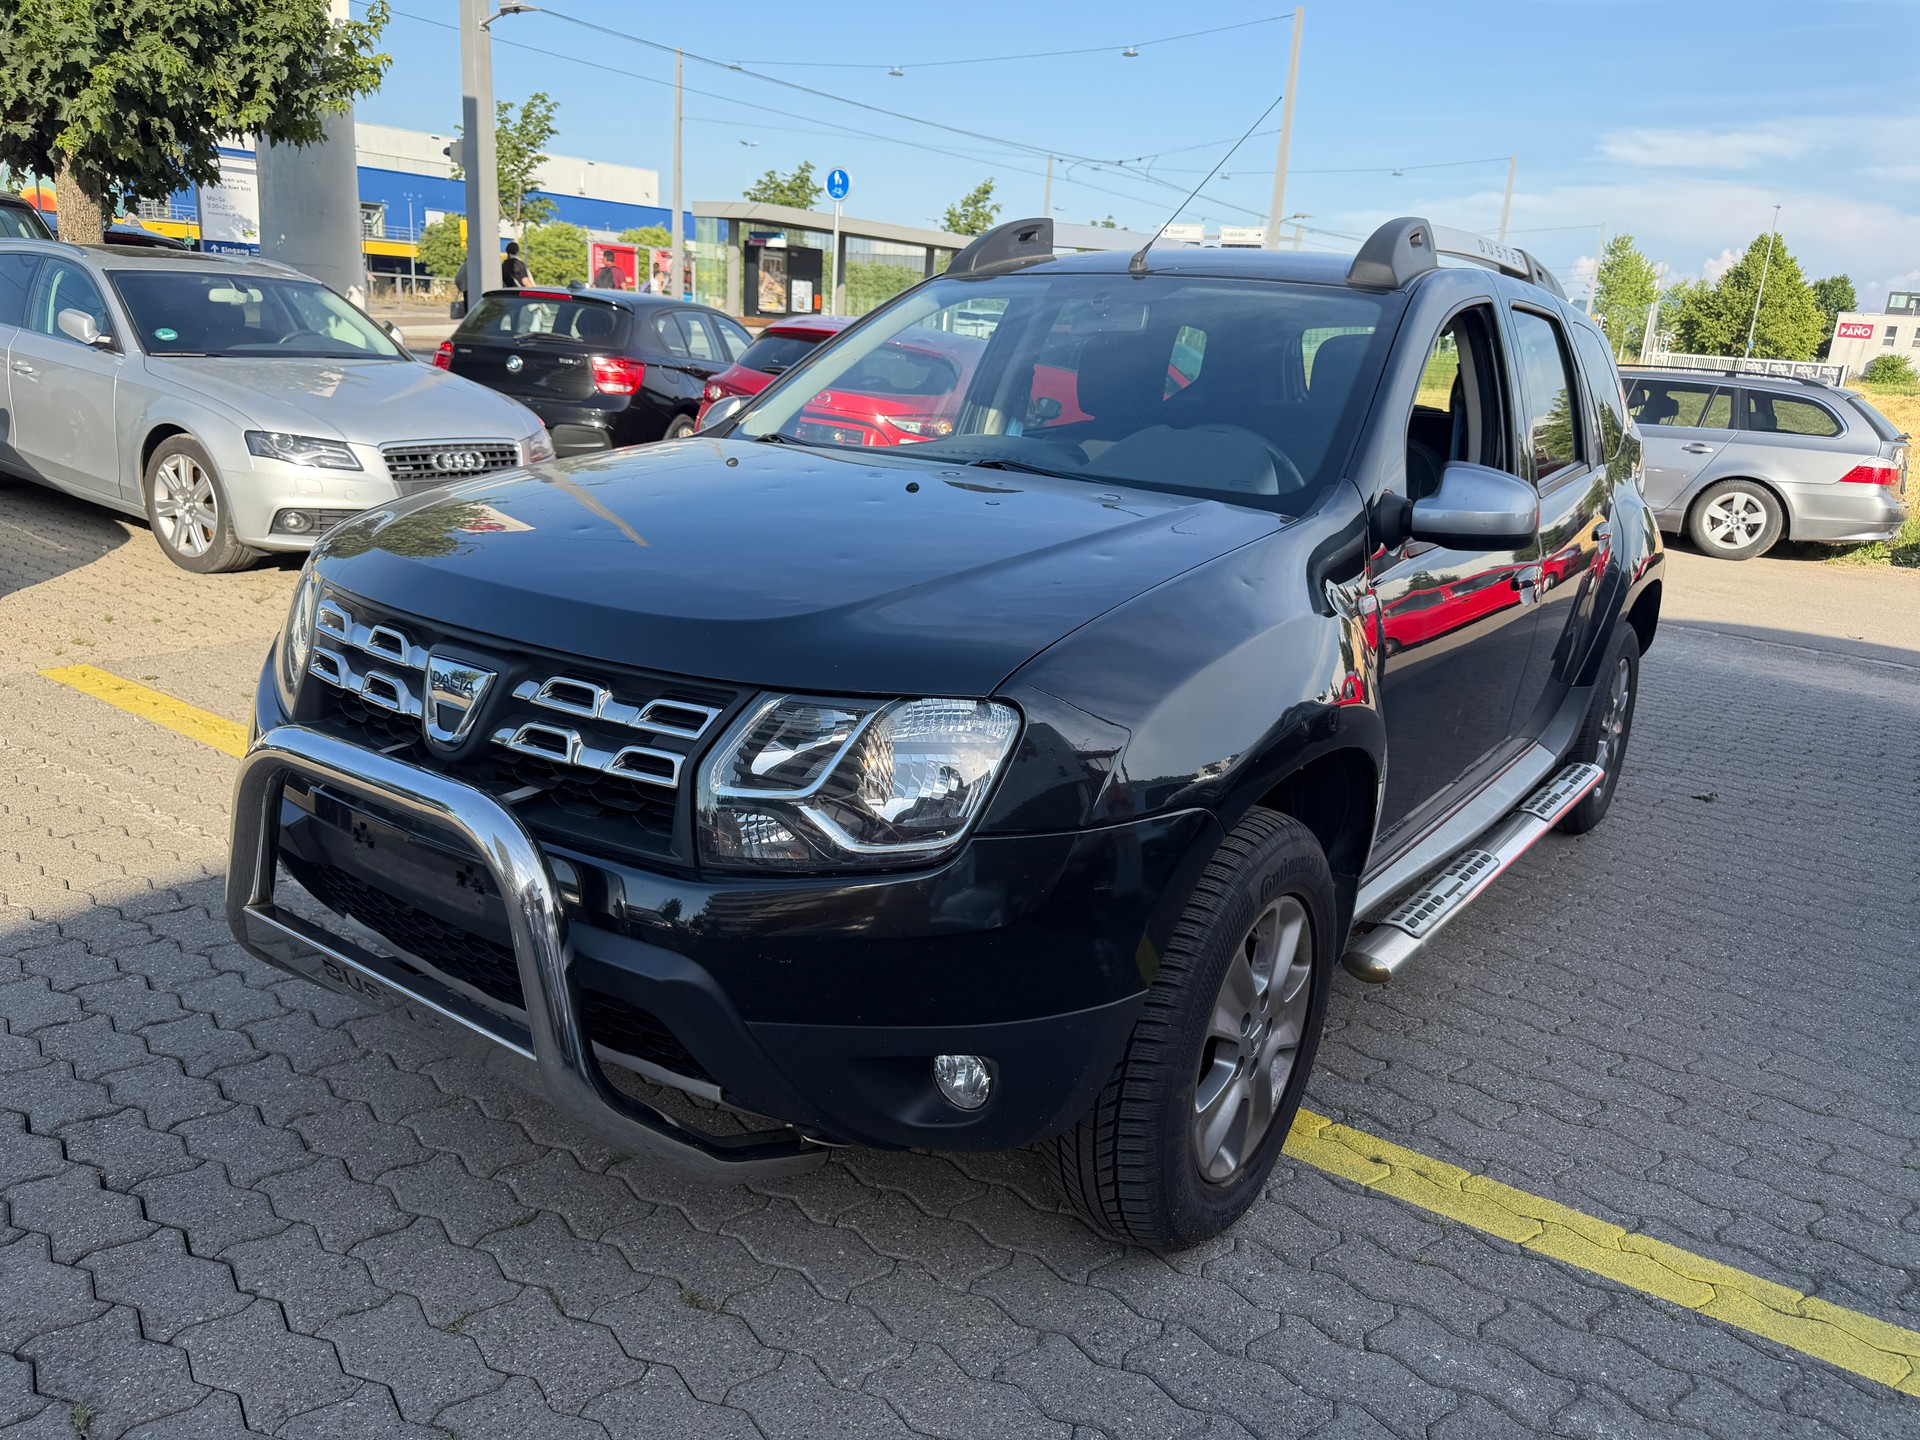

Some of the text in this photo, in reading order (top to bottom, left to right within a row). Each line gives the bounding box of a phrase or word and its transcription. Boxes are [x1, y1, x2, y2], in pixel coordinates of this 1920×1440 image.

[221, 246, 250, 256] Eingang
[1477, 239, 1526, 269] DUSTER
[1839, 326, 1871, 337] PANO
[432, 670, 475, 694] DACIA
[1260, 854, 1320, 905] Continental
